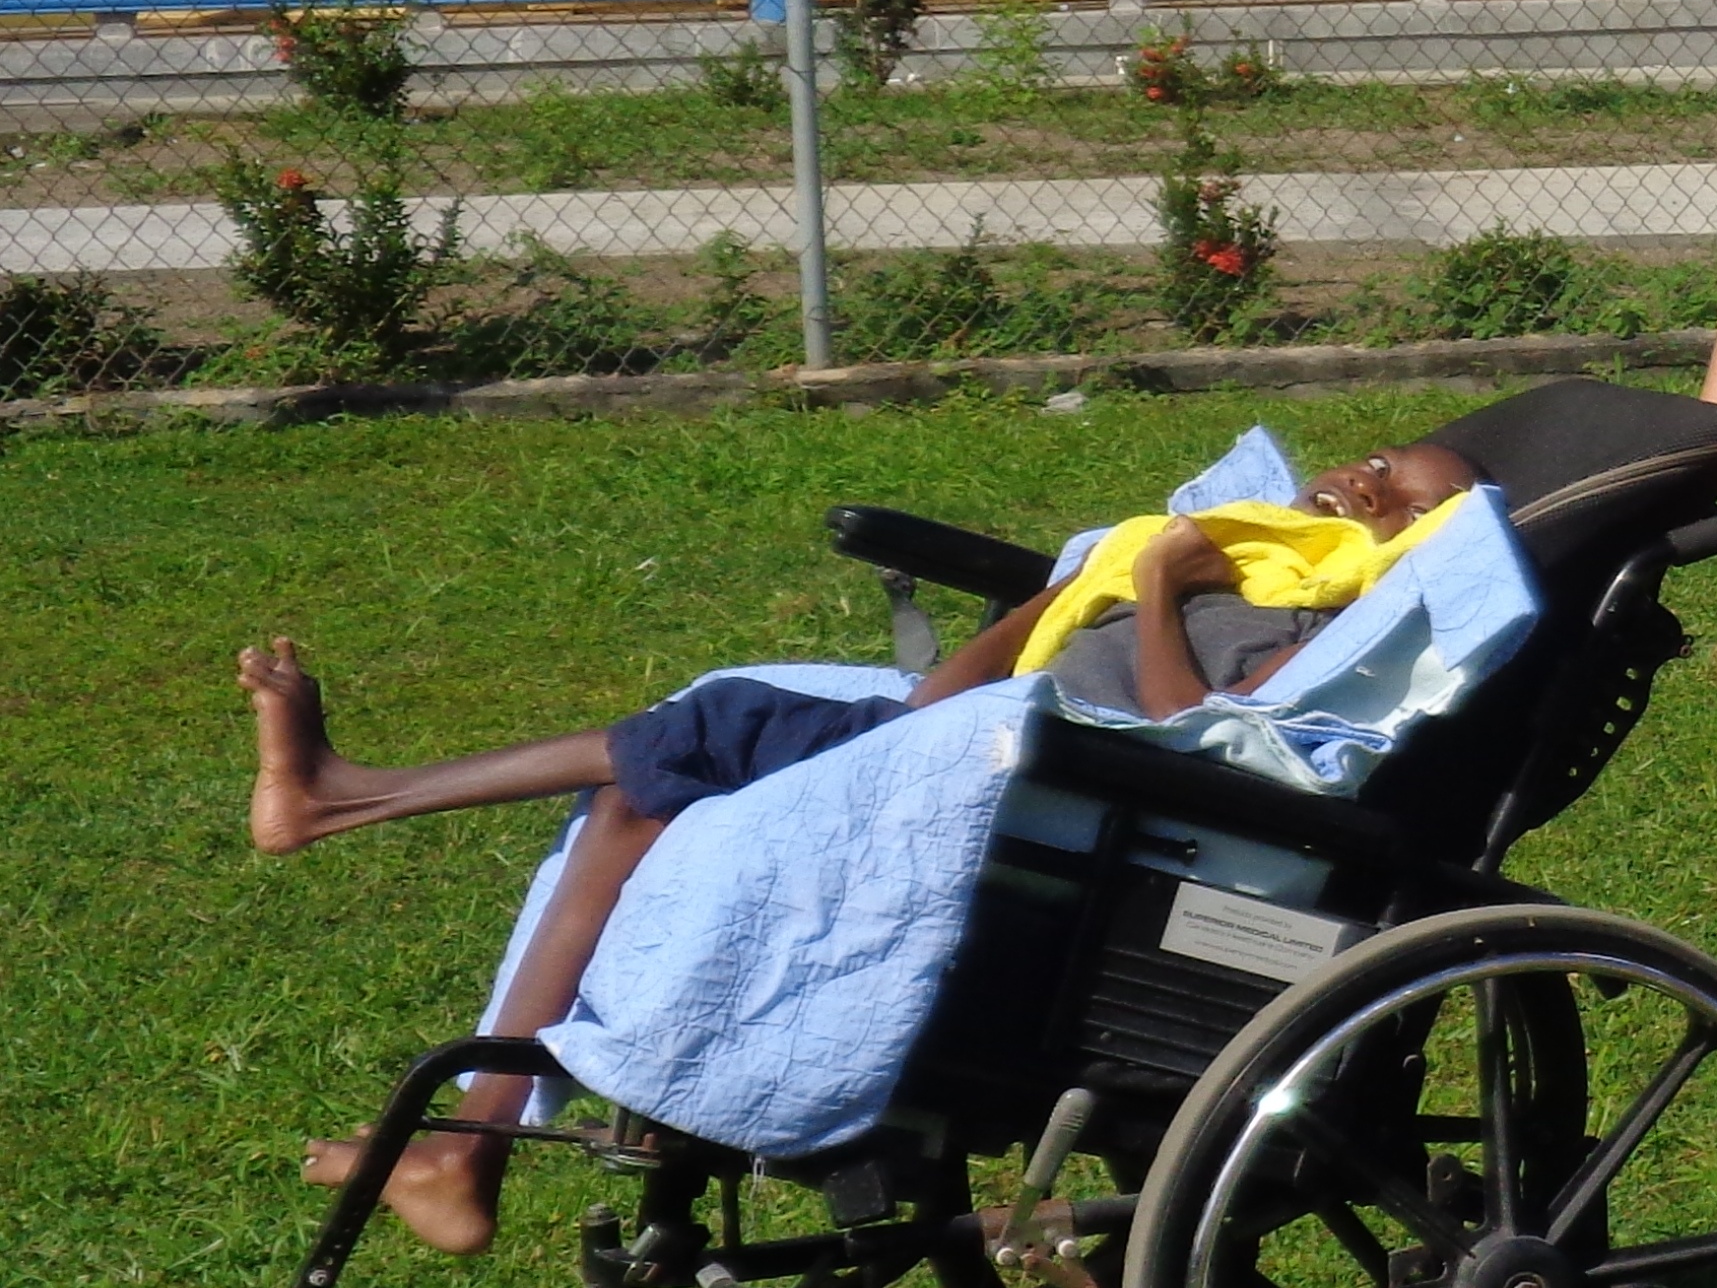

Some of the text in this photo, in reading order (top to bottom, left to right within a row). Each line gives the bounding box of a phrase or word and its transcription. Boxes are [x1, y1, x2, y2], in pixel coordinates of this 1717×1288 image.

[1182, 910, 1324, 953] SUPERIOR MEDICAL LIMITED
